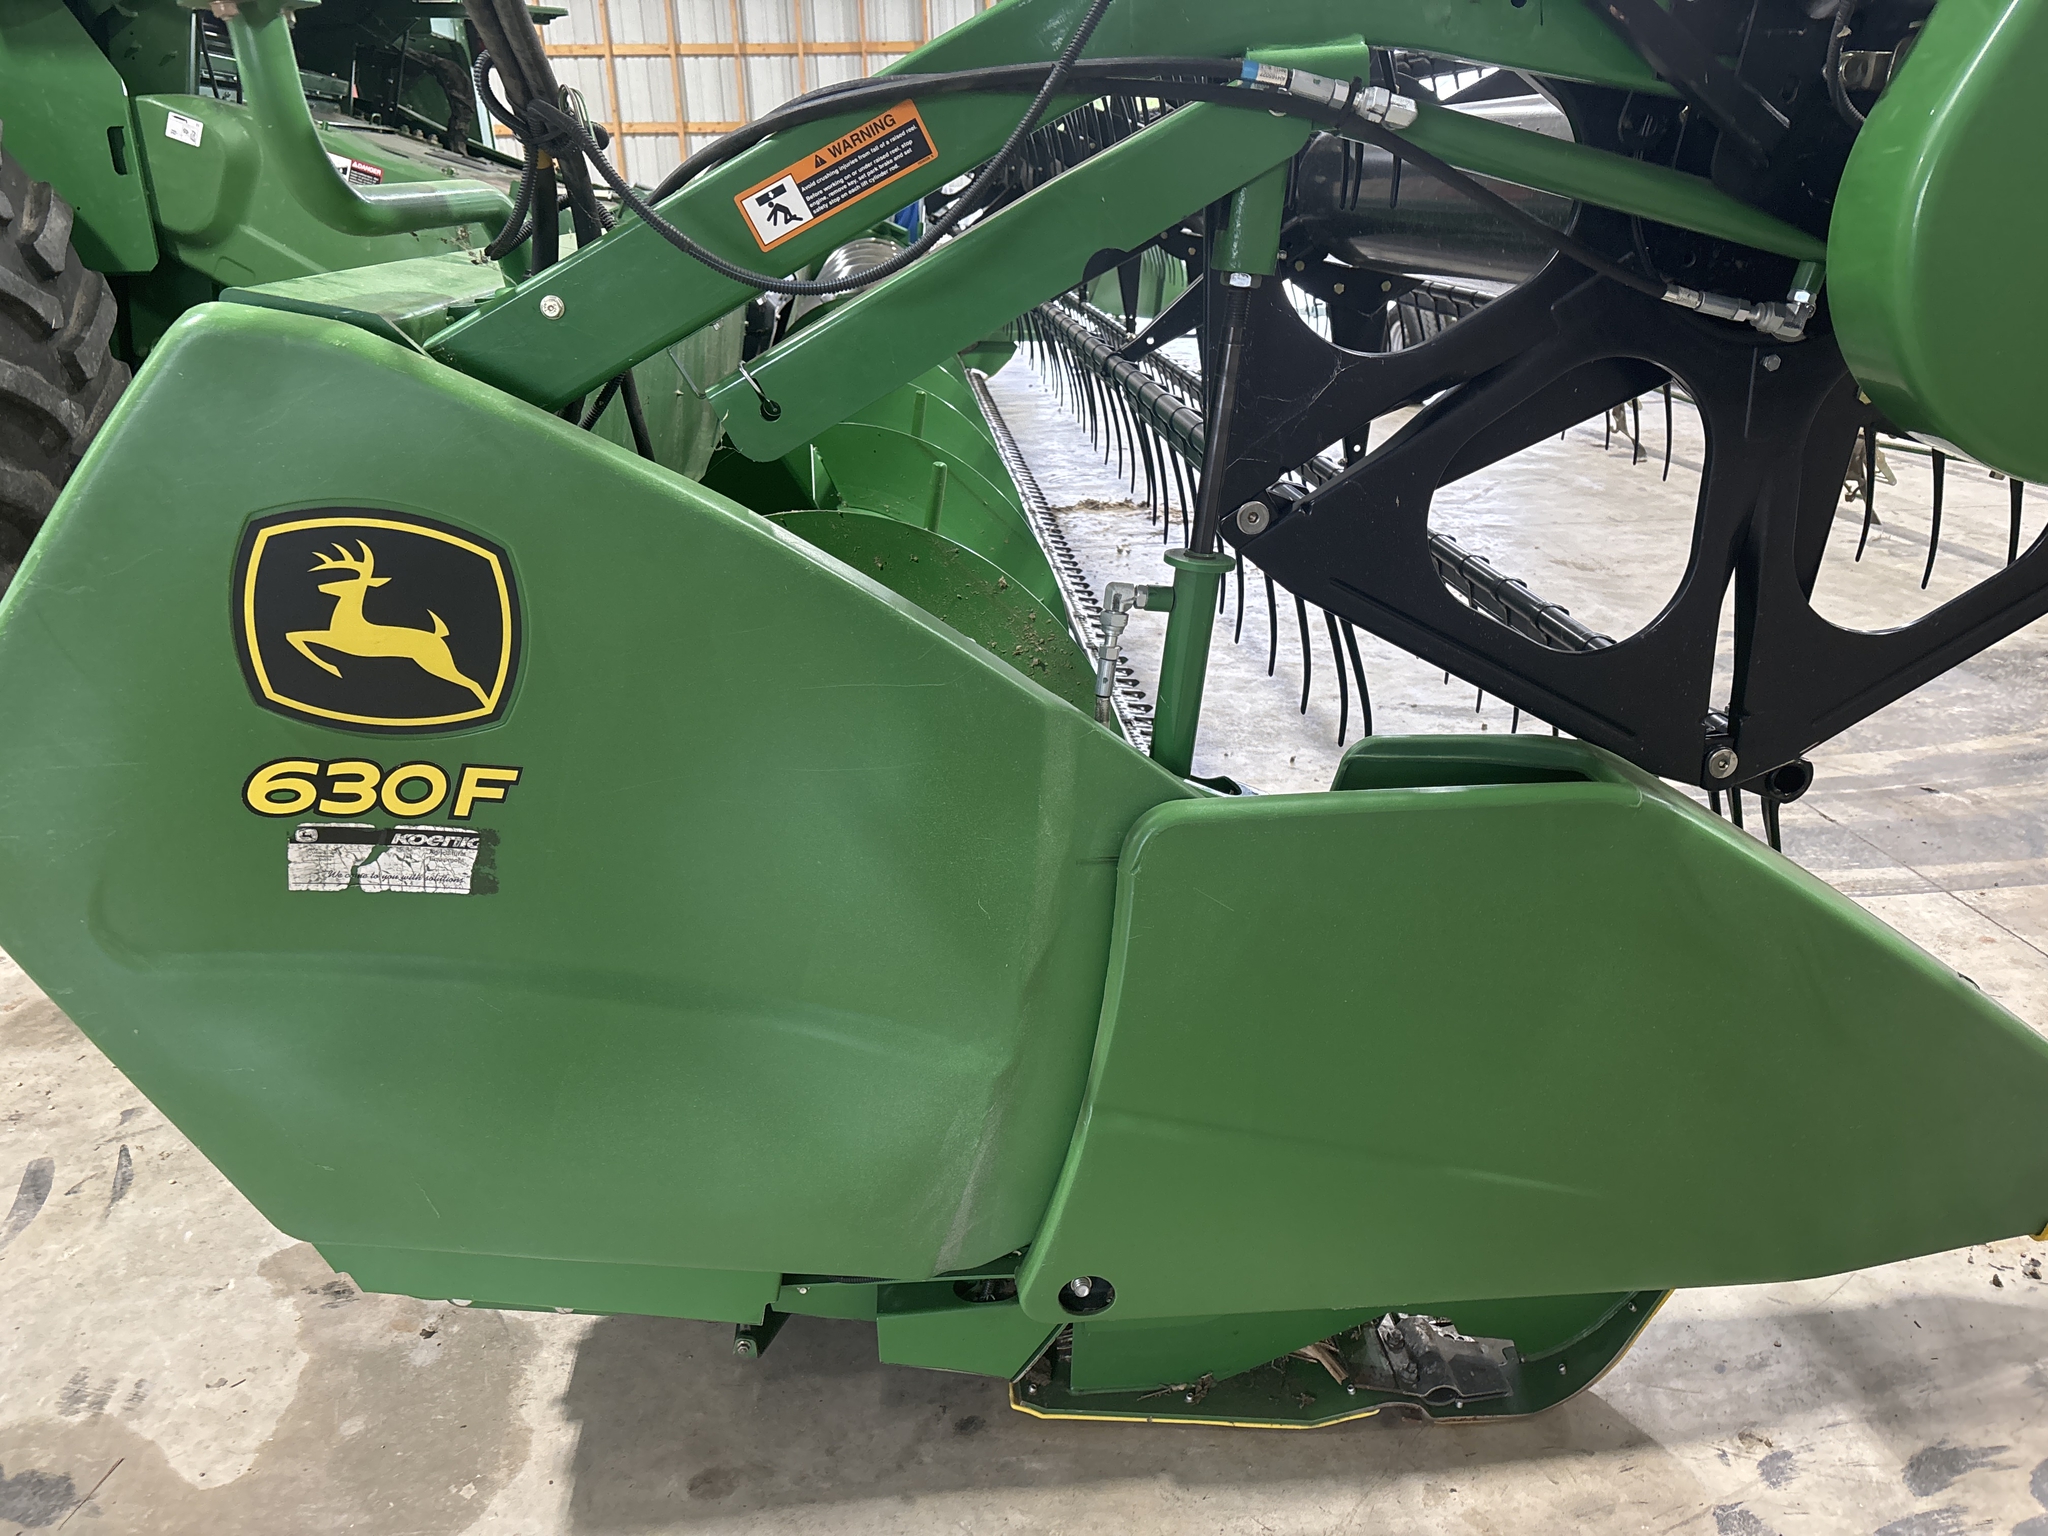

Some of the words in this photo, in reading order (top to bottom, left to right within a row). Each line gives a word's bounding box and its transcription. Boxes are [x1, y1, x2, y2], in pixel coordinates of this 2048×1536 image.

[801, 180, 816, 192] Avoid
[816, 168, 839, 183] crushing
[838, 158, 858, 170] injuries
[857, 150, 870, 160] from
[870, 145, 879, 153] fall
[889, 130, 905, 142] raised
[905, 124, 918, 134] reel.
[827, 113, 897, 158] WARNING
[357, 163, 382, 176] DANGER
[805, 189, 823, 201] Before
[822, 178, 844, 191] working
[857, 161, 872, 172] under
[873, 151, 889, 163] raised
[889, 145, 901, 154] reel,
[900, 139, 912, 148] stop
[809, 195, 828, 207] engine,
[828, 184, 847, 197] remove
[846, 178, 858, 186] key,
[866, 166, 878, 176] park
[877, 158, 893, 169] brake
[893, 152, 903, 161] and
[903, 147, 912, 155] set
[812, 202, 828, 213] safety
[828, 196, 840, 205] stop
[847, 185, 860, 194] each
[868, 169, 888, 182] cylinder
[243, 758, 522, 819] 630F
[381, 873, 400, 882] you
[402, 872, 422, 882] with
